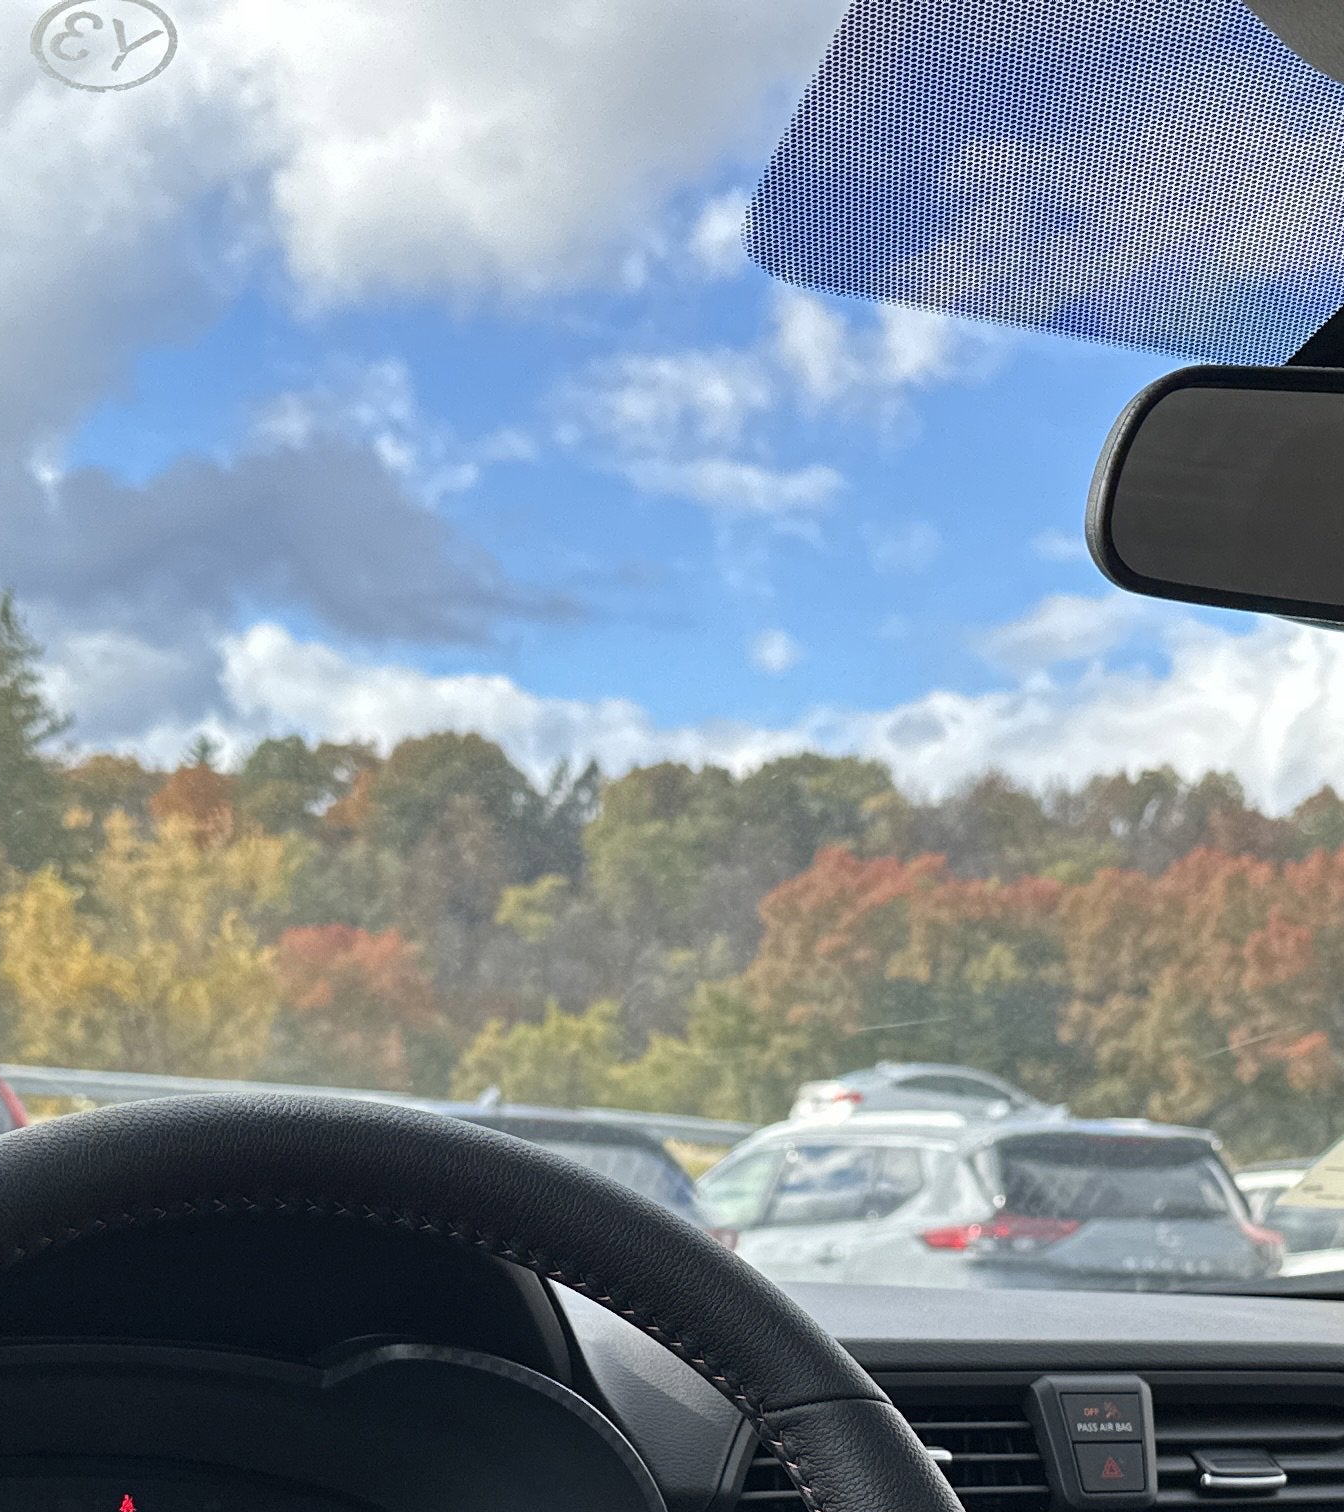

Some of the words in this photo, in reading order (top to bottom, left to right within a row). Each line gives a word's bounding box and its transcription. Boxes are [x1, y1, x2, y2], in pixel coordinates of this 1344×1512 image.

[1077, 1422, 1098, 1432] PASS
[1100, 1422, 1113, 1432] AIR
[1115, 1422, 1133, 1432] BAG
